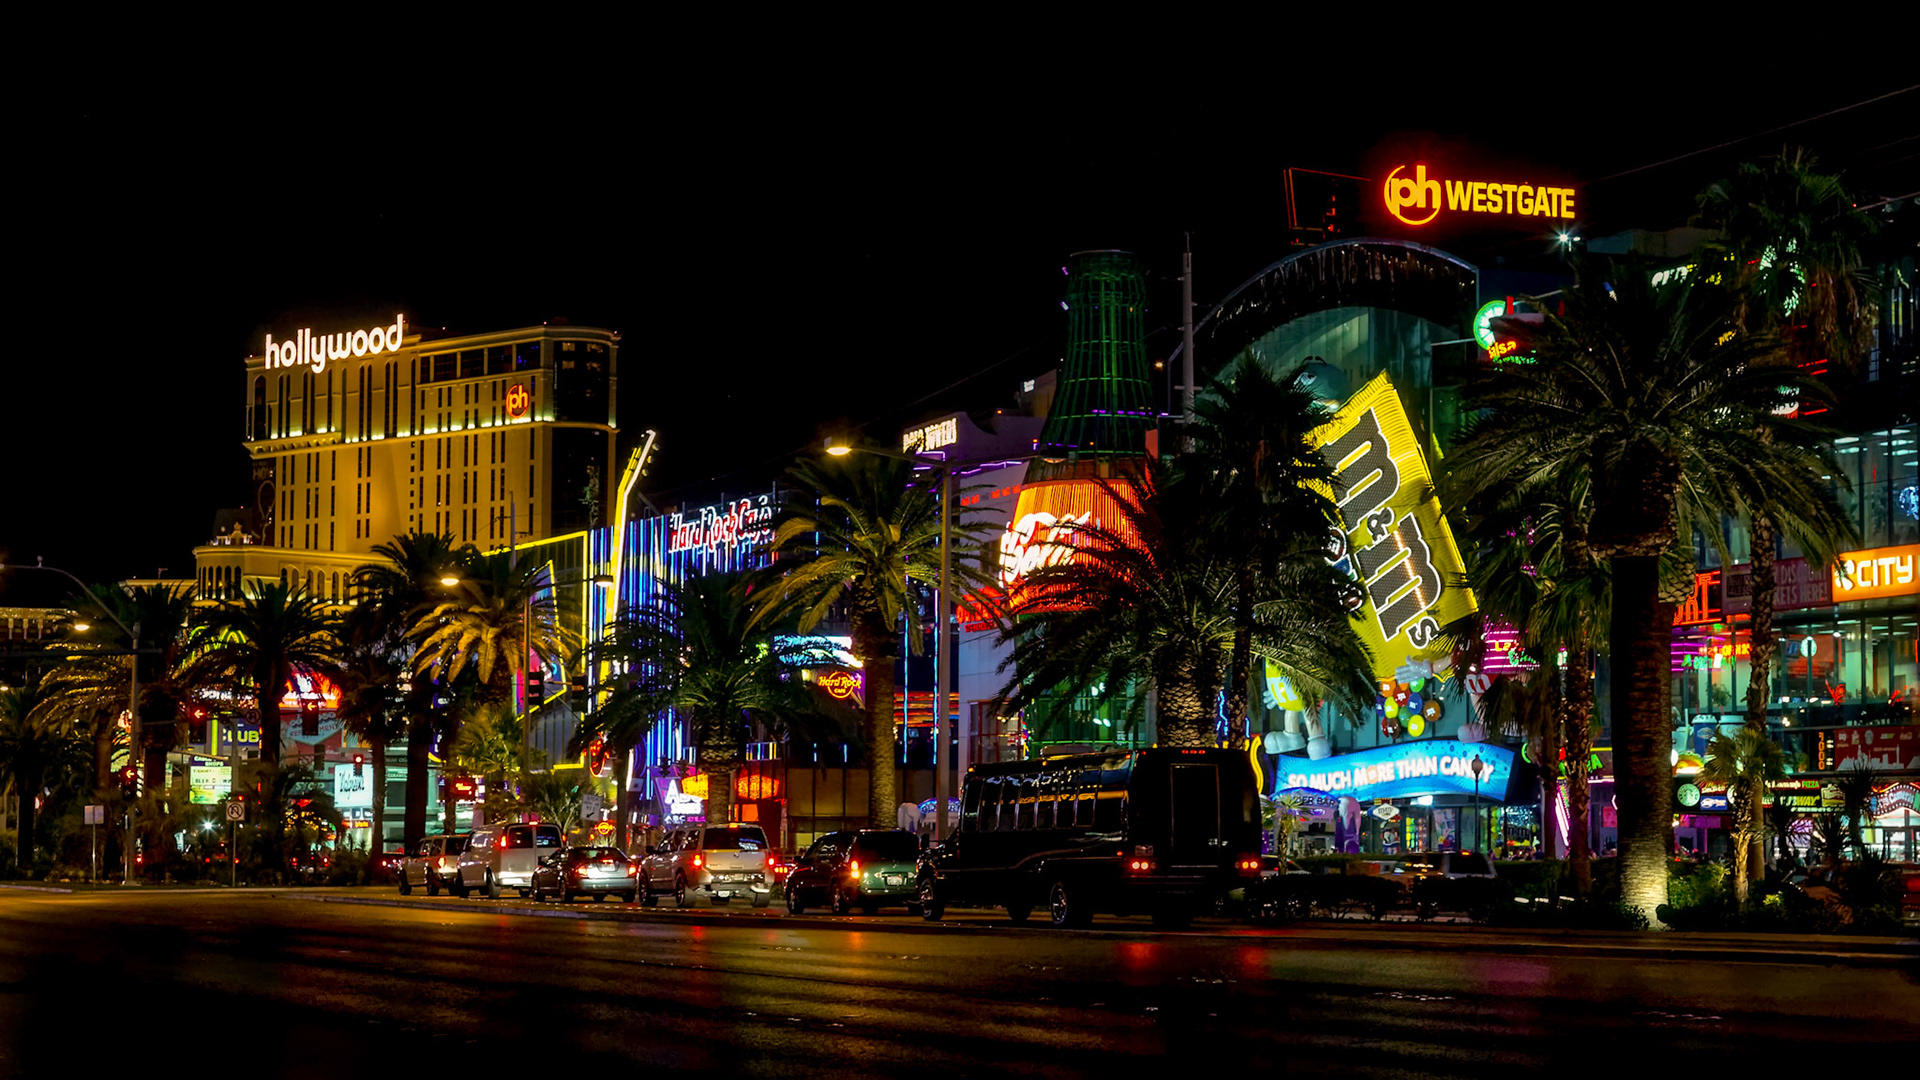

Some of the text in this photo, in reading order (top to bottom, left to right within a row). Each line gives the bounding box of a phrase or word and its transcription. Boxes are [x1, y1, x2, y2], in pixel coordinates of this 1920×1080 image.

[1445, 180, 1575, 219] WESTGATE
[265, 313, 404, 374] hollywood
[668, 508, 705, 553] Hard
[702, 502, 738, 553] Rock
[1856, 555, 1912, 588] CITY
[819, 676, 861, 689] Hard Rock
[222, 728, 260, 743] LUB
[1288, 773, 1308, 788] SO
[1309, 767, 1352, 792] MUCH
[1396, 756, 1438, 780] THAN
